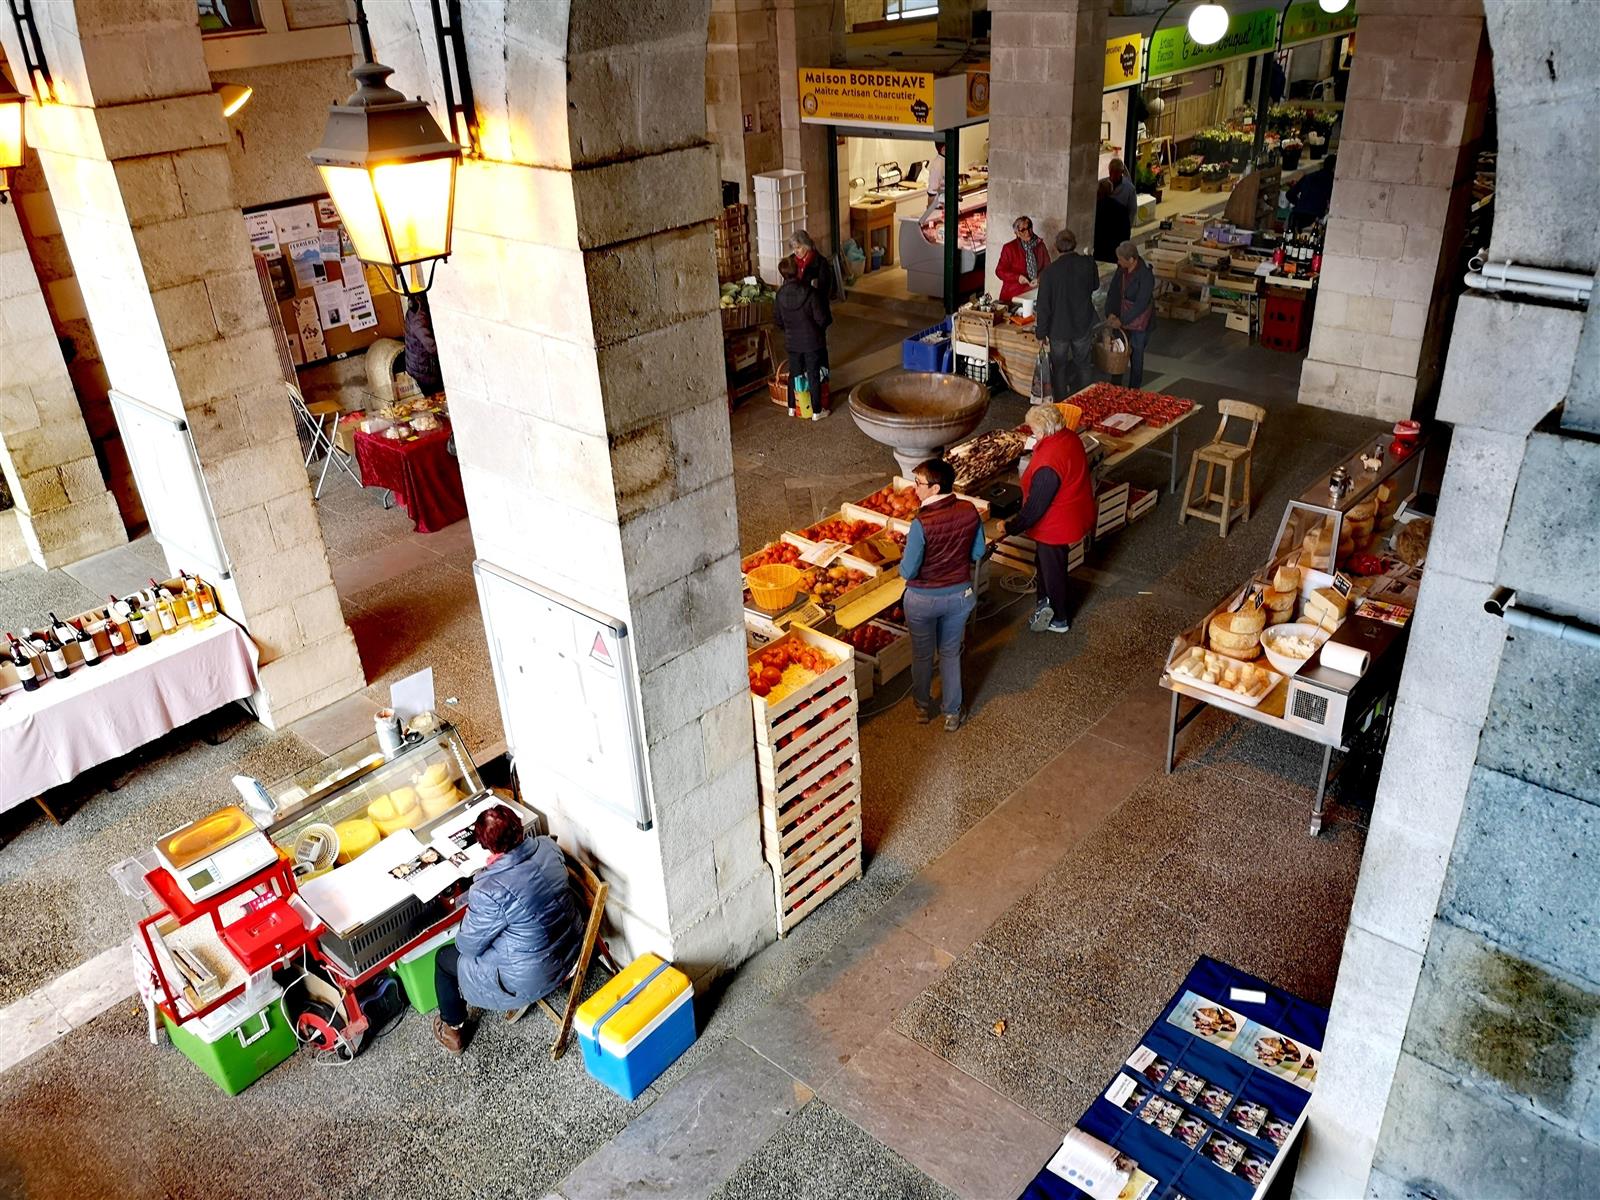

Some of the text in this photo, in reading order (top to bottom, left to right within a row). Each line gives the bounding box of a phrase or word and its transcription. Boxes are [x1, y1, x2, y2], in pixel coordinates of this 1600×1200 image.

[805, 72, 925, 88] Maison BORDENAVE
[841, 88, 870, 98] Artisan
[873, 89, 916, 100] Charcutier
